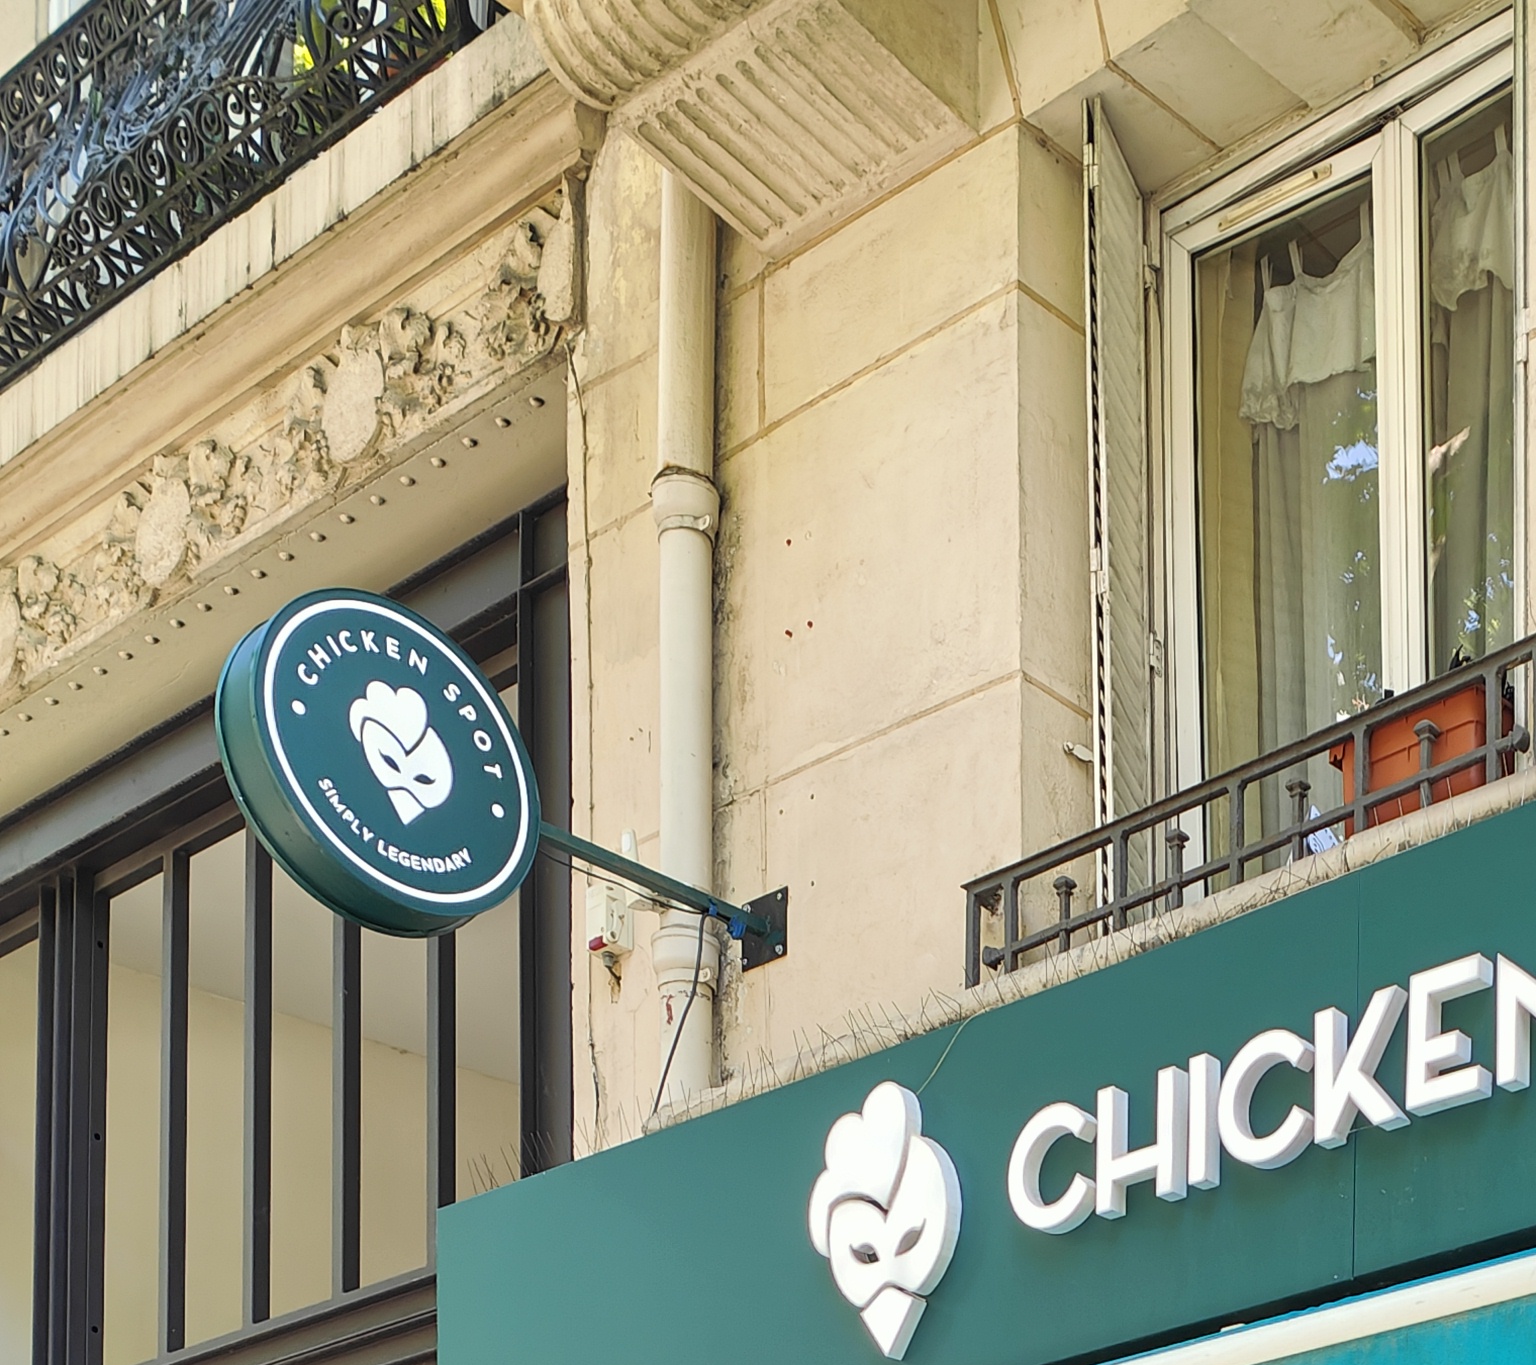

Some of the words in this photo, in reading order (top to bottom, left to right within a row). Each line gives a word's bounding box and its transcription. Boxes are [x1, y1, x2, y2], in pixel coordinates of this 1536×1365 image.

[298, 629, 429, 685] CHICKEN
[443, 683, 503, 779] SPOT
[318, 778, 374, 842] SIMPLY
[377, 839, 473, 873] LEGENDARY
